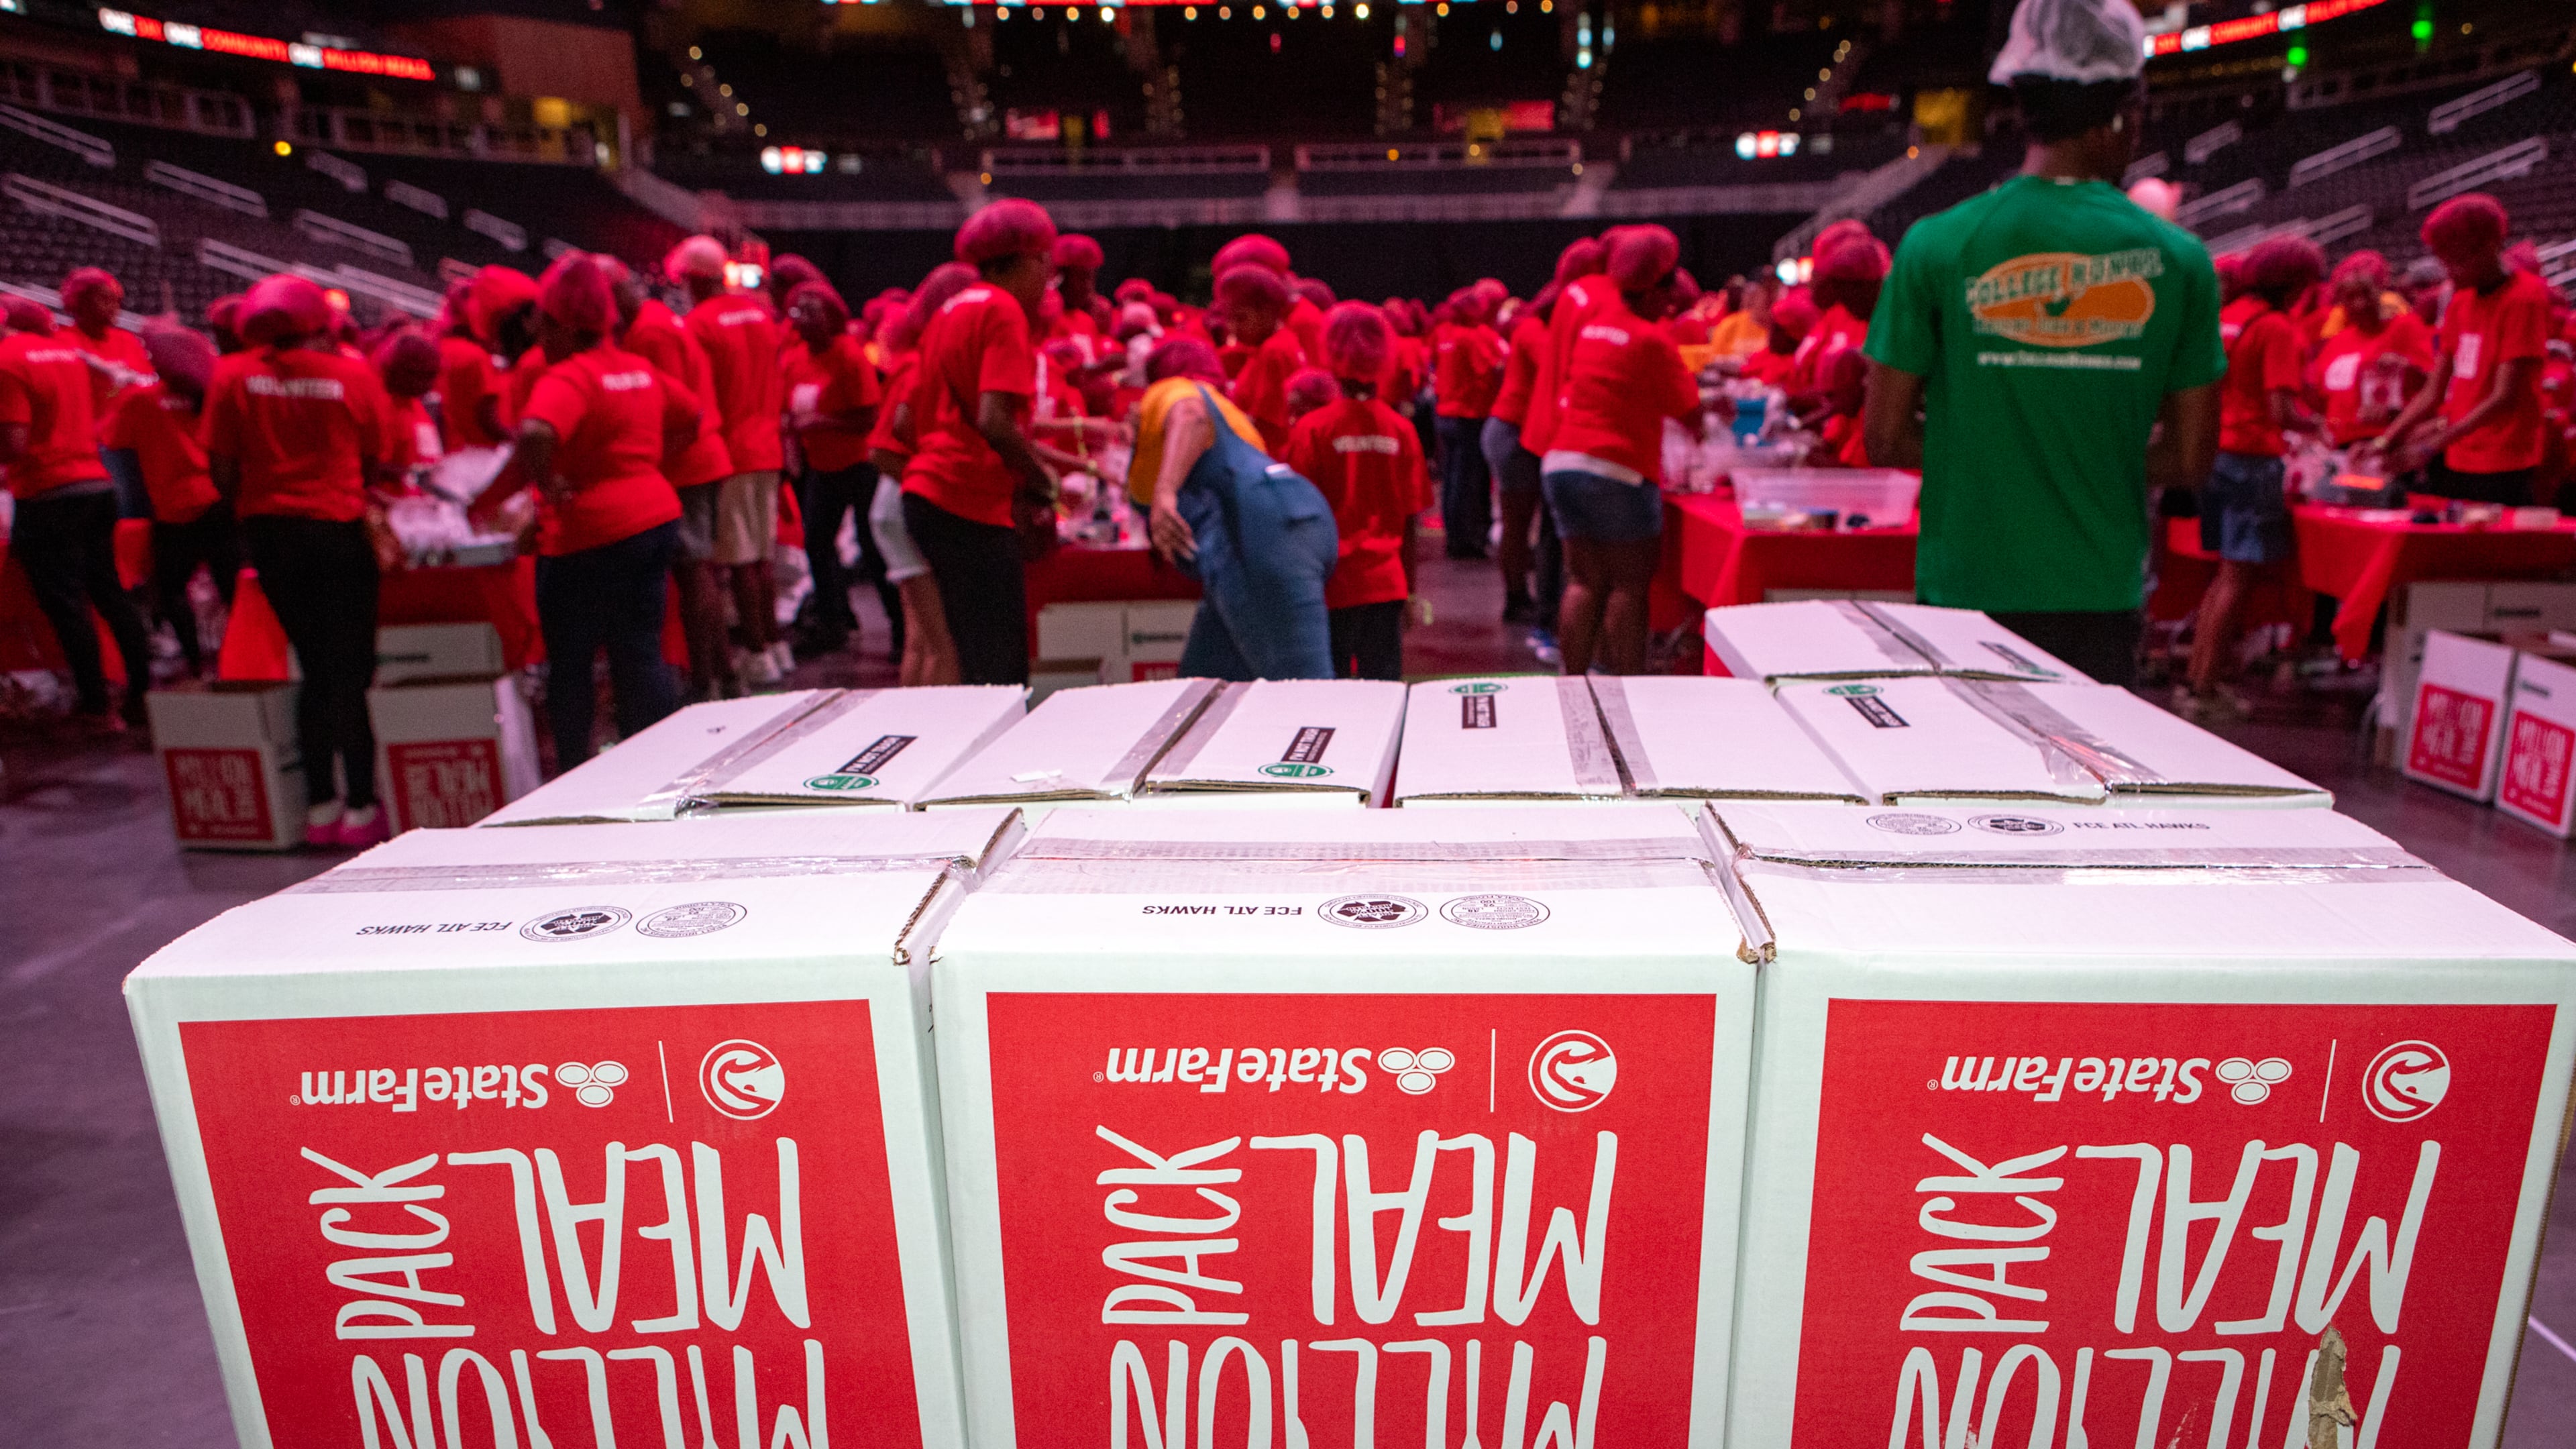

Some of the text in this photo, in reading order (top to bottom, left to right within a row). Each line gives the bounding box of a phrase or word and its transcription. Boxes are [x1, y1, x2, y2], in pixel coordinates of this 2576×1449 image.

[356, 921, 513, 935] FCE ATL HAWKS
[1142, 906, 1302, 916] FCE ATL HAWKS
[301, 1146, 476, 1340] PACK
[447, 1137, 811, 1335] MEAL
[1096, 1125, 1250, 1326] PACK
[1250, 1130, 1618, 1326] MEAL
[1900, 1133, 2068, 1333] PACK
[2076, 1140, 2441, 1335] MEAL
